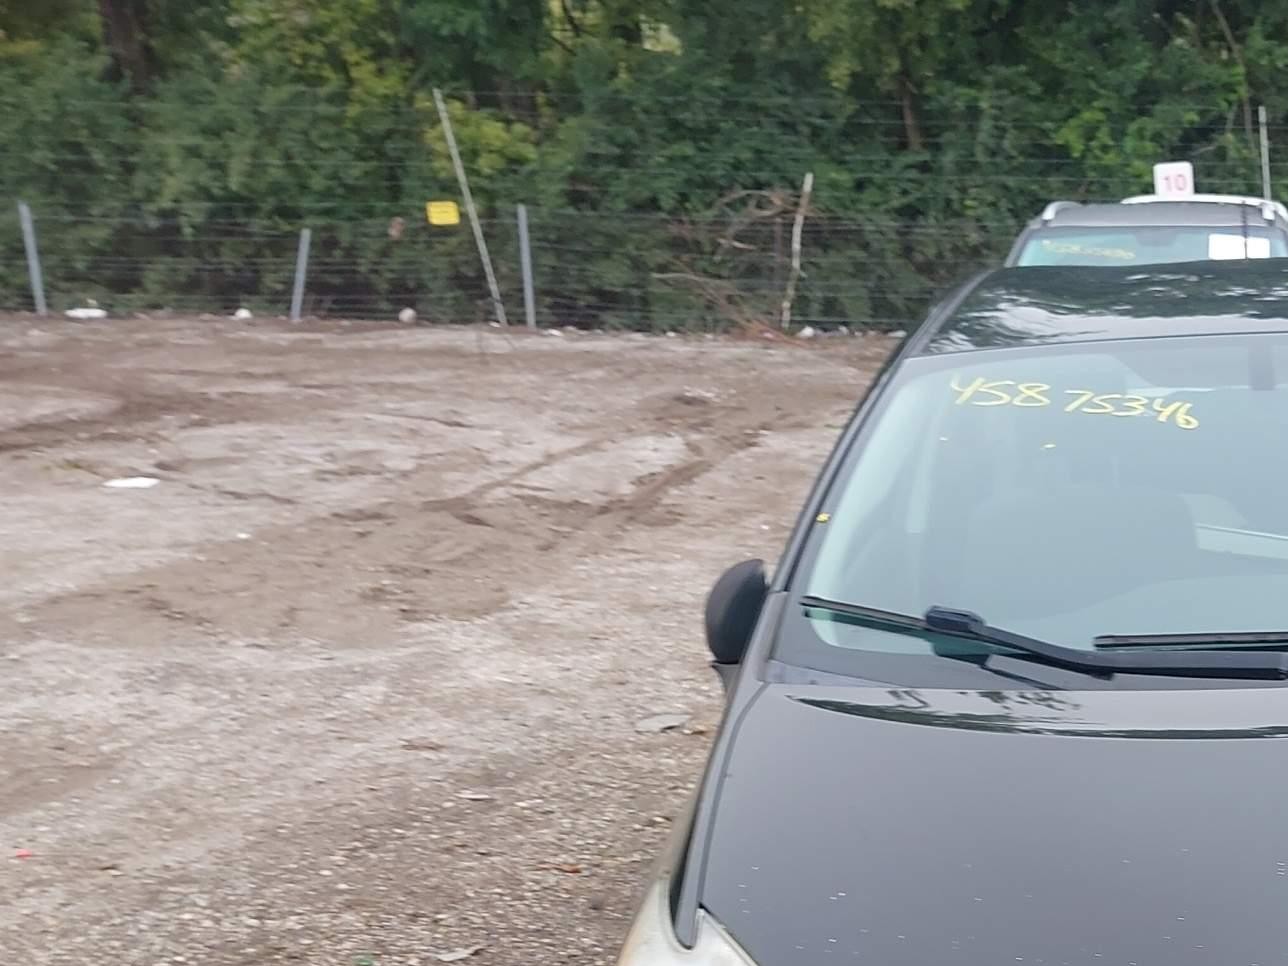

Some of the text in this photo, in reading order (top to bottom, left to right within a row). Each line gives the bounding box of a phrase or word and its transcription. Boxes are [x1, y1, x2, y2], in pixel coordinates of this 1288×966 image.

[1162, 173, 1188, 192] 10
[950, 373, 1199, 429] 458 75346
